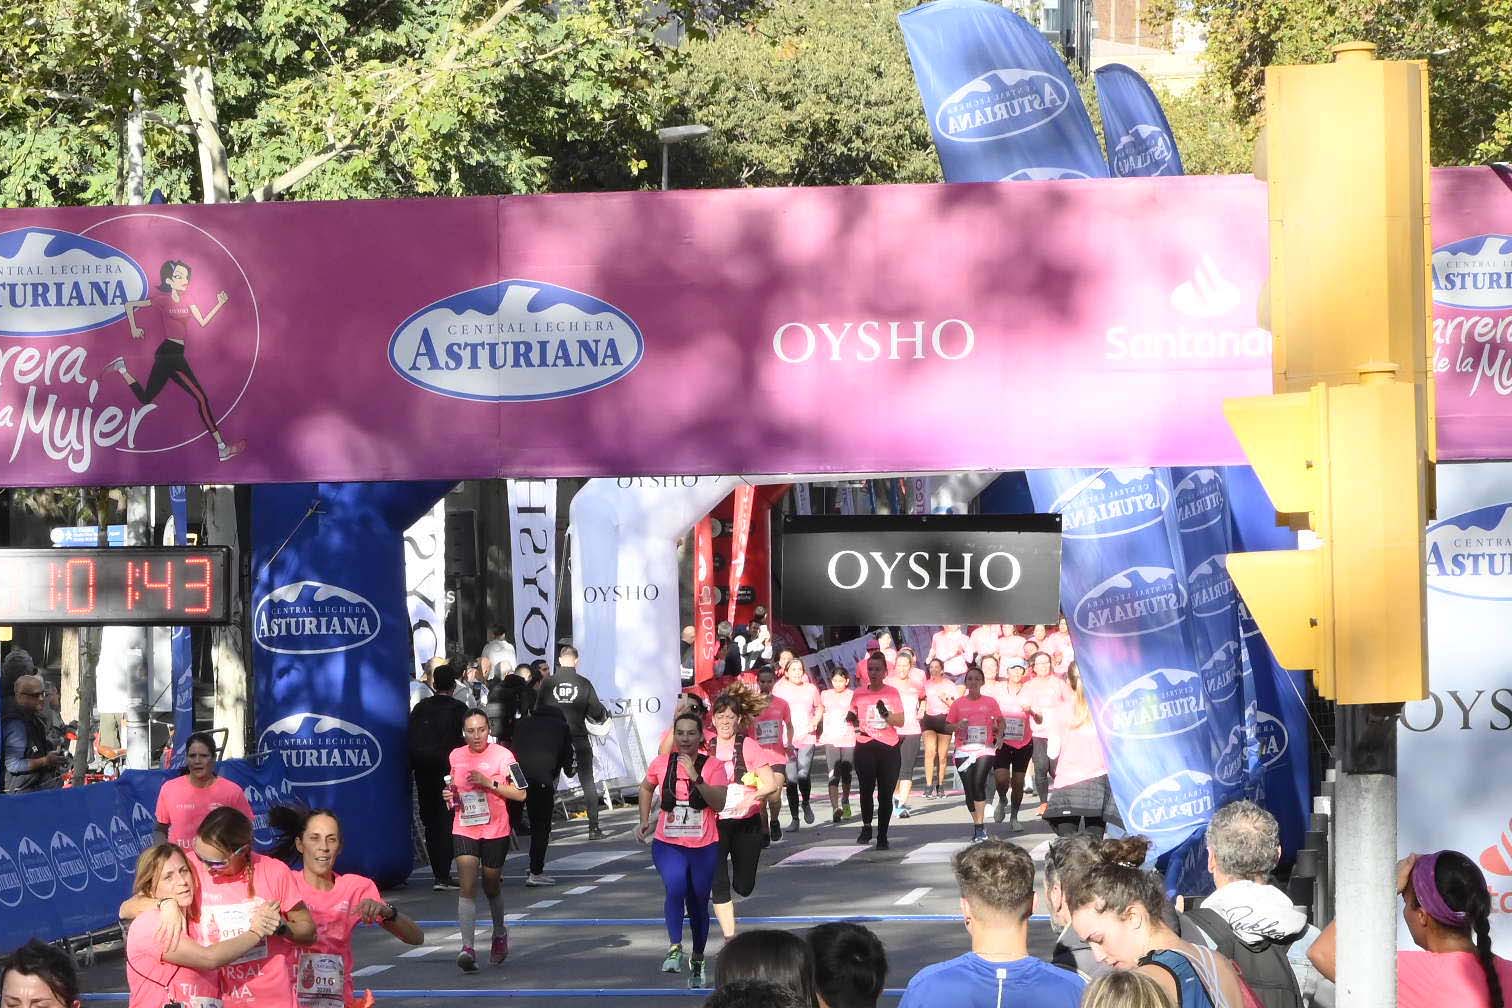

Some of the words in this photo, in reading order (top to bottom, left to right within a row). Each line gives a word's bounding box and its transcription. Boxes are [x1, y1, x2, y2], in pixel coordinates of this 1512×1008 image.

[50, 262, 122, 276] LECHERA
[448, 322, 527, 336] CENTRAL
[533, 320, 615, 333] LECHERA
[409, 327, 623, 371] ASTURIANA
[773, 318, 975, 363] OYSHO
[9, 378, 158, 473] Mujer
[827, 550, 1022, 592] OYSHO
[583, 584, 659, 604] OYSHO
[271, 606, 313, 616] CENTRAL
[317, 605, 367, 615] LECHERA
[259, 611, 372, 638] ASTURIANA
[315, 976, 334, 986] 016
